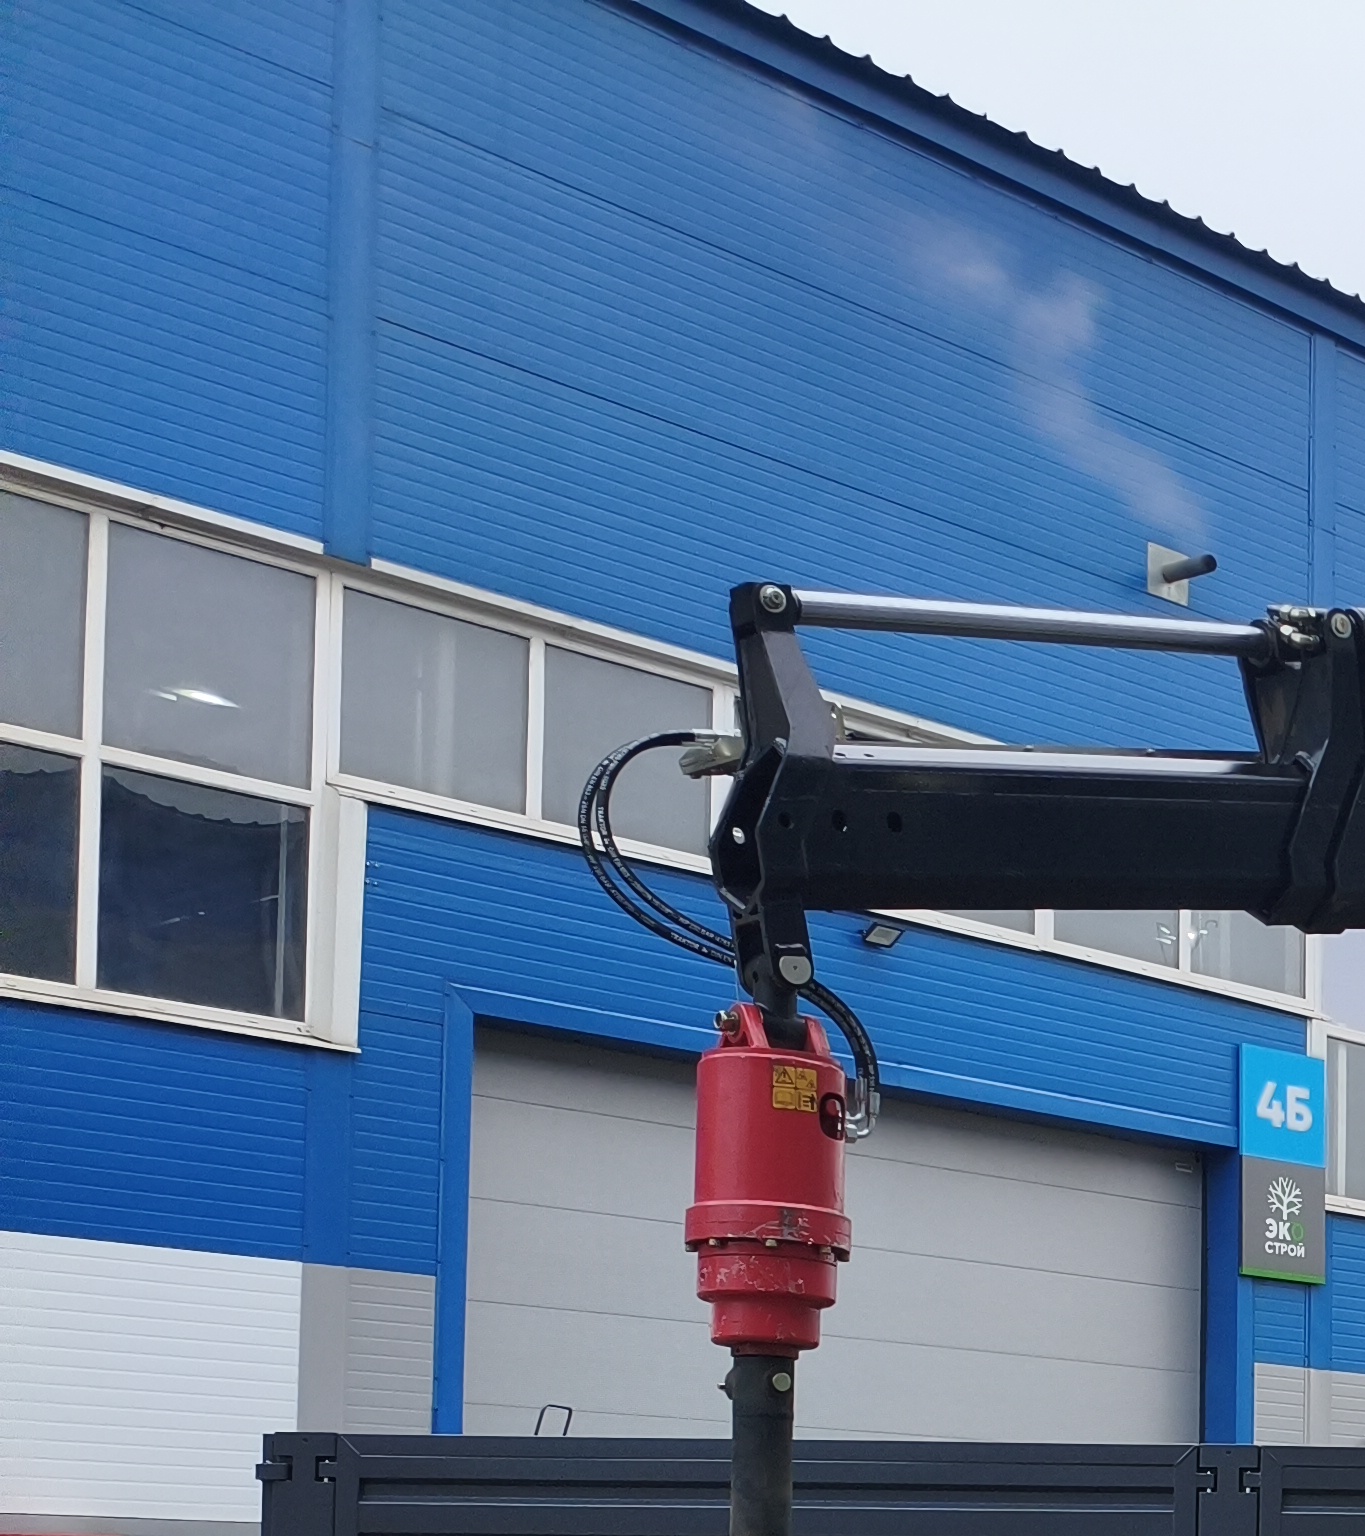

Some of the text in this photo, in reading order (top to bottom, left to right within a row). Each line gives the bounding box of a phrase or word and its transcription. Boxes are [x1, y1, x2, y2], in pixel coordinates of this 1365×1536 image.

[1256, 1081, 1313, 1132] 4Б
[1264, 1217, 1304, 1242] ЭКО
[1264, 1240, 1305, 1258] СТРОЙ
